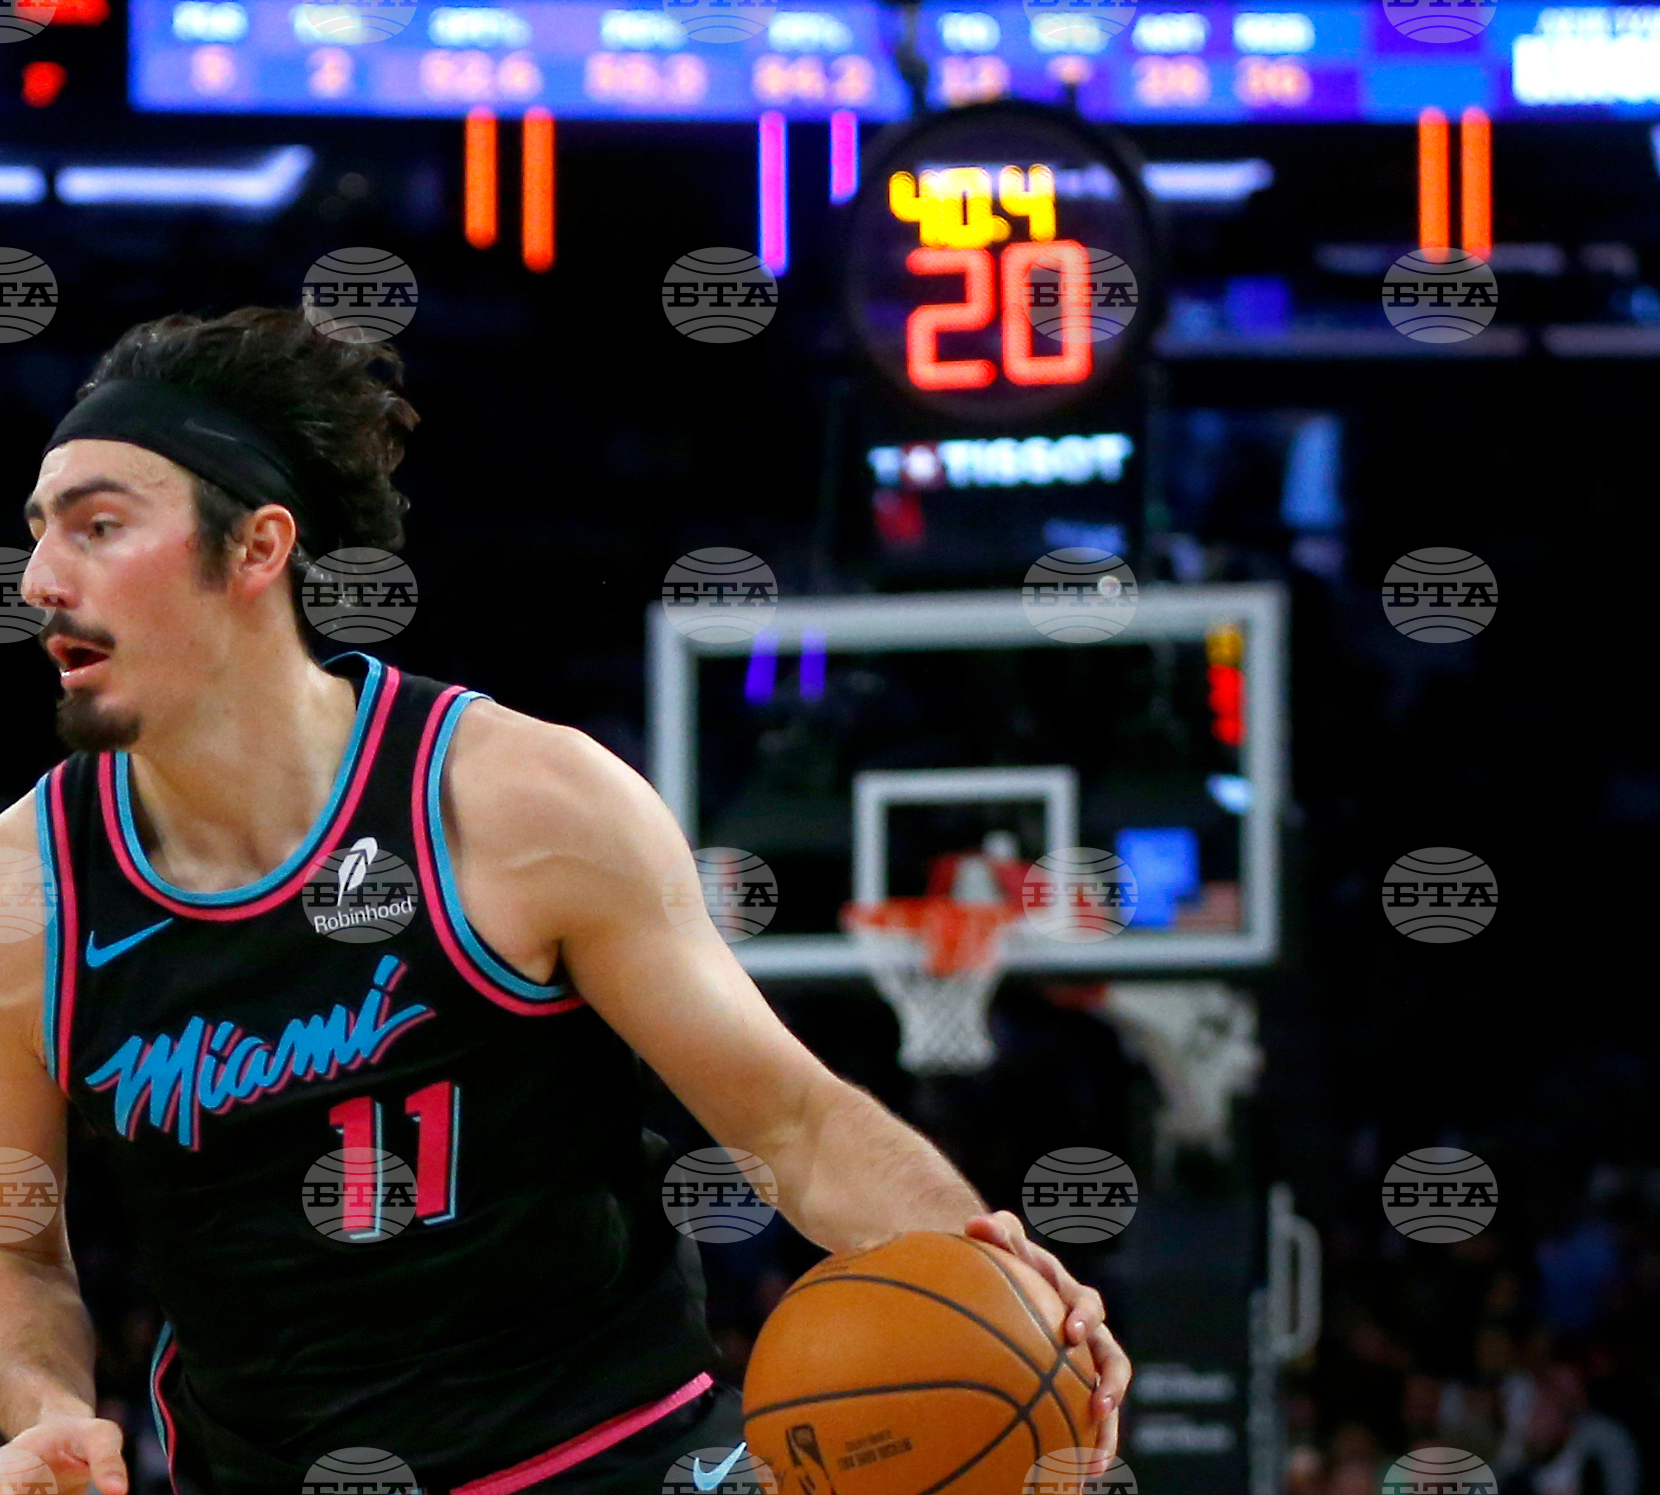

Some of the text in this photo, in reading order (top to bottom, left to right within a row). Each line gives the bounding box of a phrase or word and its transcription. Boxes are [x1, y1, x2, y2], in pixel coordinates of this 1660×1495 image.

[905, 238, 1093, 391] 20
[314, 895, 413, 933] Robinhood
[85, 955, 437, 1152] Miami
[329, 1080, 461, 1240] 11
